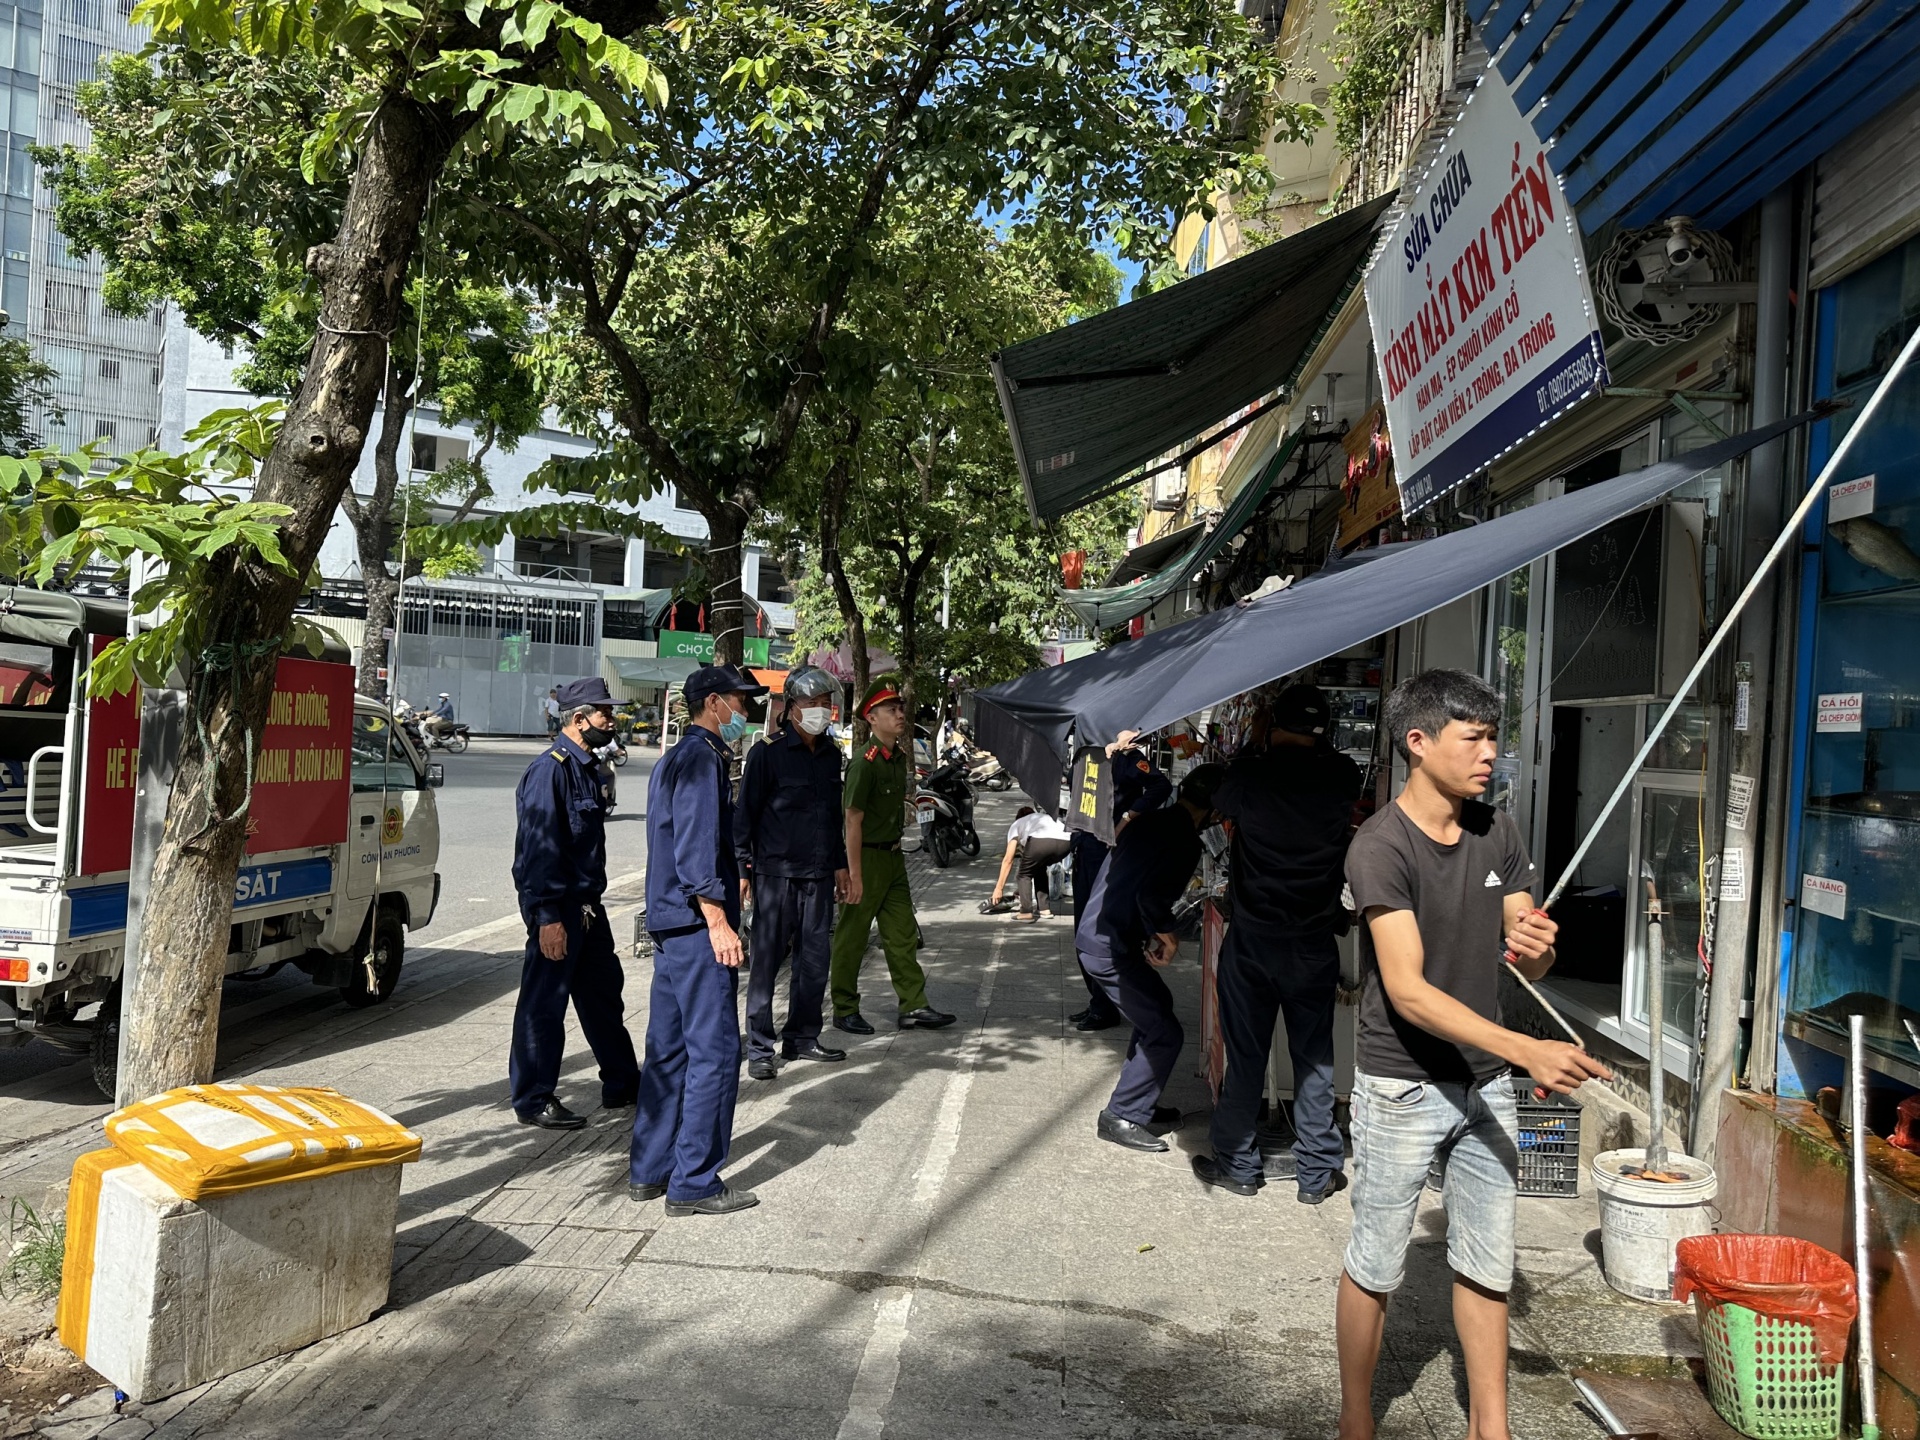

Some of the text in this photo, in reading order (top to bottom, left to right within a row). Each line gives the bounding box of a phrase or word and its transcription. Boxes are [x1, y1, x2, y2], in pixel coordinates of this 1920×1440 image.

[1404, 149, 1472, 273] SỬA CHỮA
[1384, 141, 1554, 401] KÍNH MẮT KIM TIẾN
[1415, 382, 1432, 412] HÀN
[1430, 371, 1443, 397] MẠ
[1445, 355, 1456, 383] ÉP
[1481, 305, 1505, 348] KÍNH
[1505, 279, 1519, 324] CỔ
[1408, 429, 1420, 459] LẮP
[1421, 420, 1434, 450] ĐẶT
[1433, 409, 1449, 439] CẬN
[1466, 387, 1474, 410] 2
[1472, 361, 1505, 404] TRÒNG,
[1503, 345, 1519, 378] ĐA
[1518, 312, 1556, 364] TRÒNG
[1536, 352, 1593, 413] ĐT: 0902255983
[677, 643, 703, 657] CHỢ
[294, 684, 331, 731] ĐƯỜNG,
[1821, 697, 1836, 708] CÁ
[105, 739, 127, 788] HÈ
[294, 741, 322, 782] BUÔN
[323, 741, 344, 780] BÁN
[361, 851, 380, 864] CÔN
[383, 851, 392, 861] AN
[235, 868, 282, 901] SÁT
